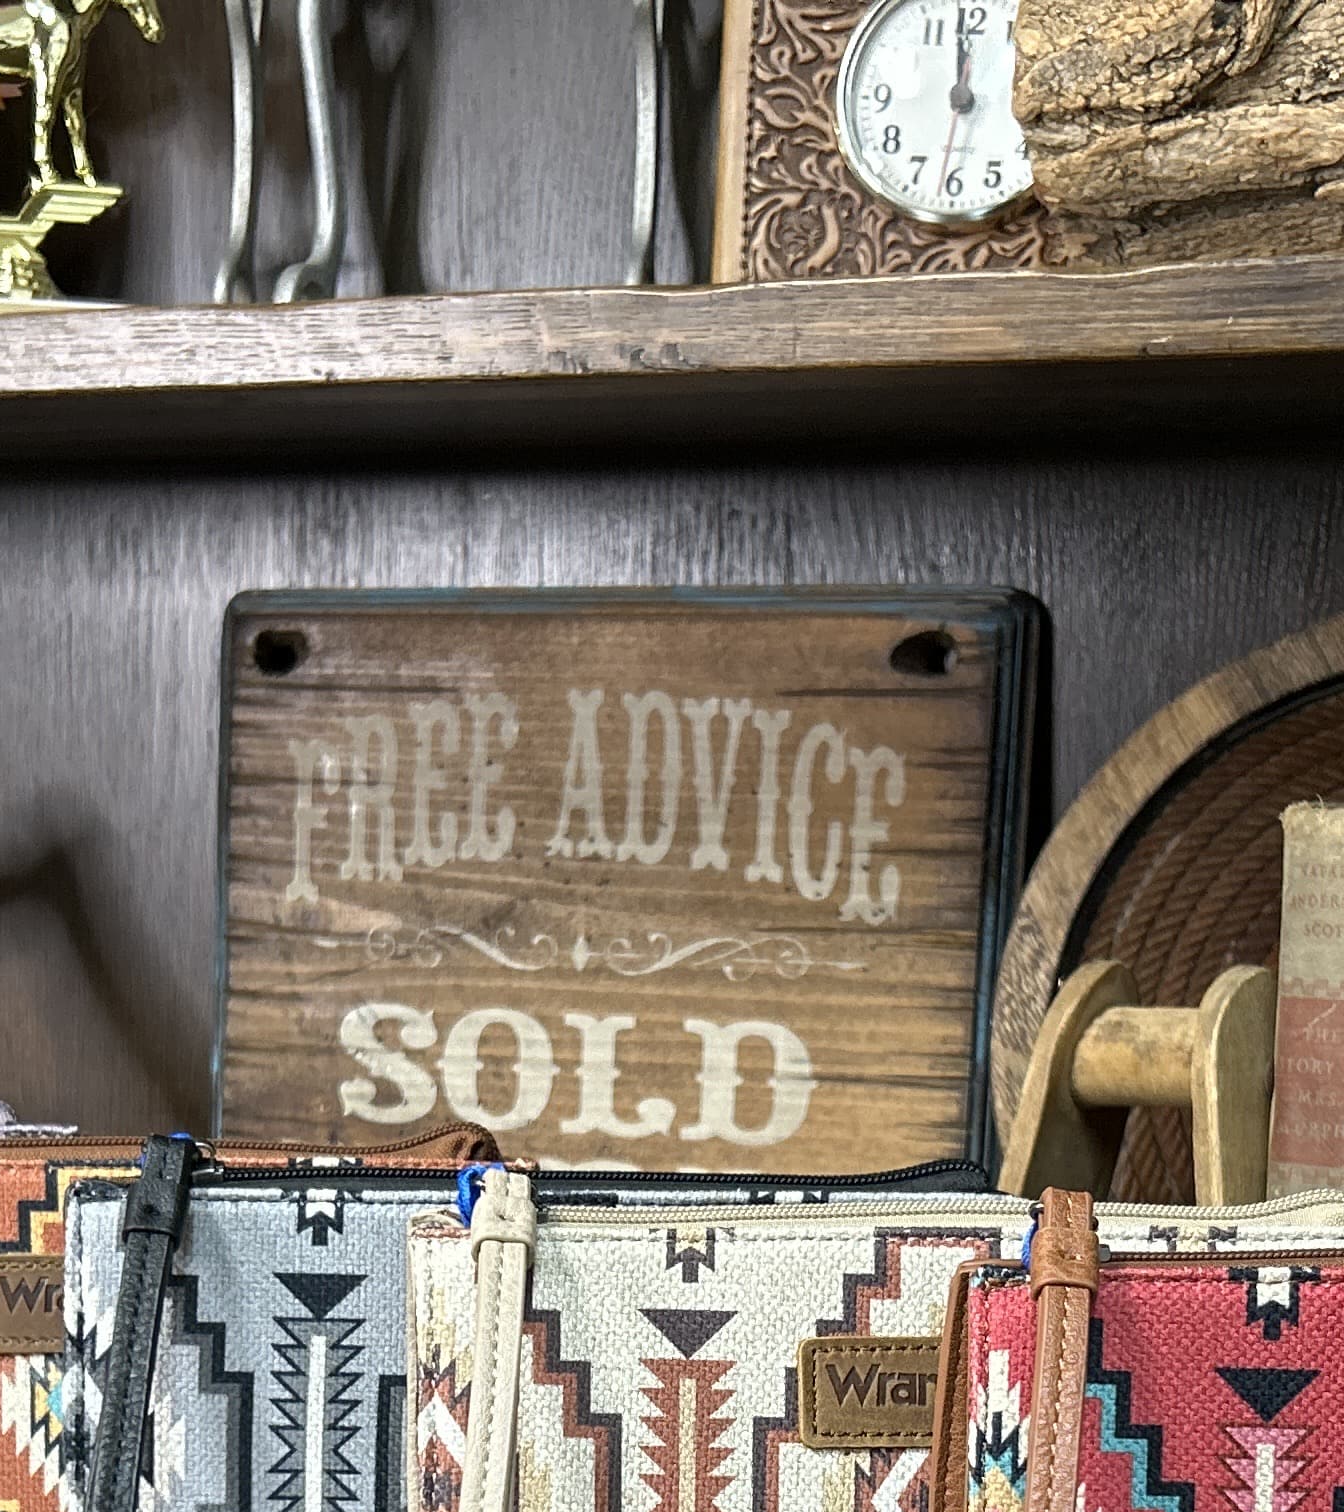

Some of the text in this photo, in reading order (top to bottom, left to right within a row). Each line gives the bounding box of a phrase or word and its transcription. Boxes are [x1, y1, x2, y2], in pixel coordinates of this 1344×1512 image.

[922, 19, 944, 46] 11
[957, 7, 987, 36] 12
[873, 84, 892, 113] 9
[882, 125, 901, 154] 8
[909, 156, 928, 185] 7
[945, 167, 963, 197] 6
[983, 161, 1002, 188] 5
[285, 688, 907, 926] FREE ADVICE
[338, 1002, 818, 1147] SOLD
